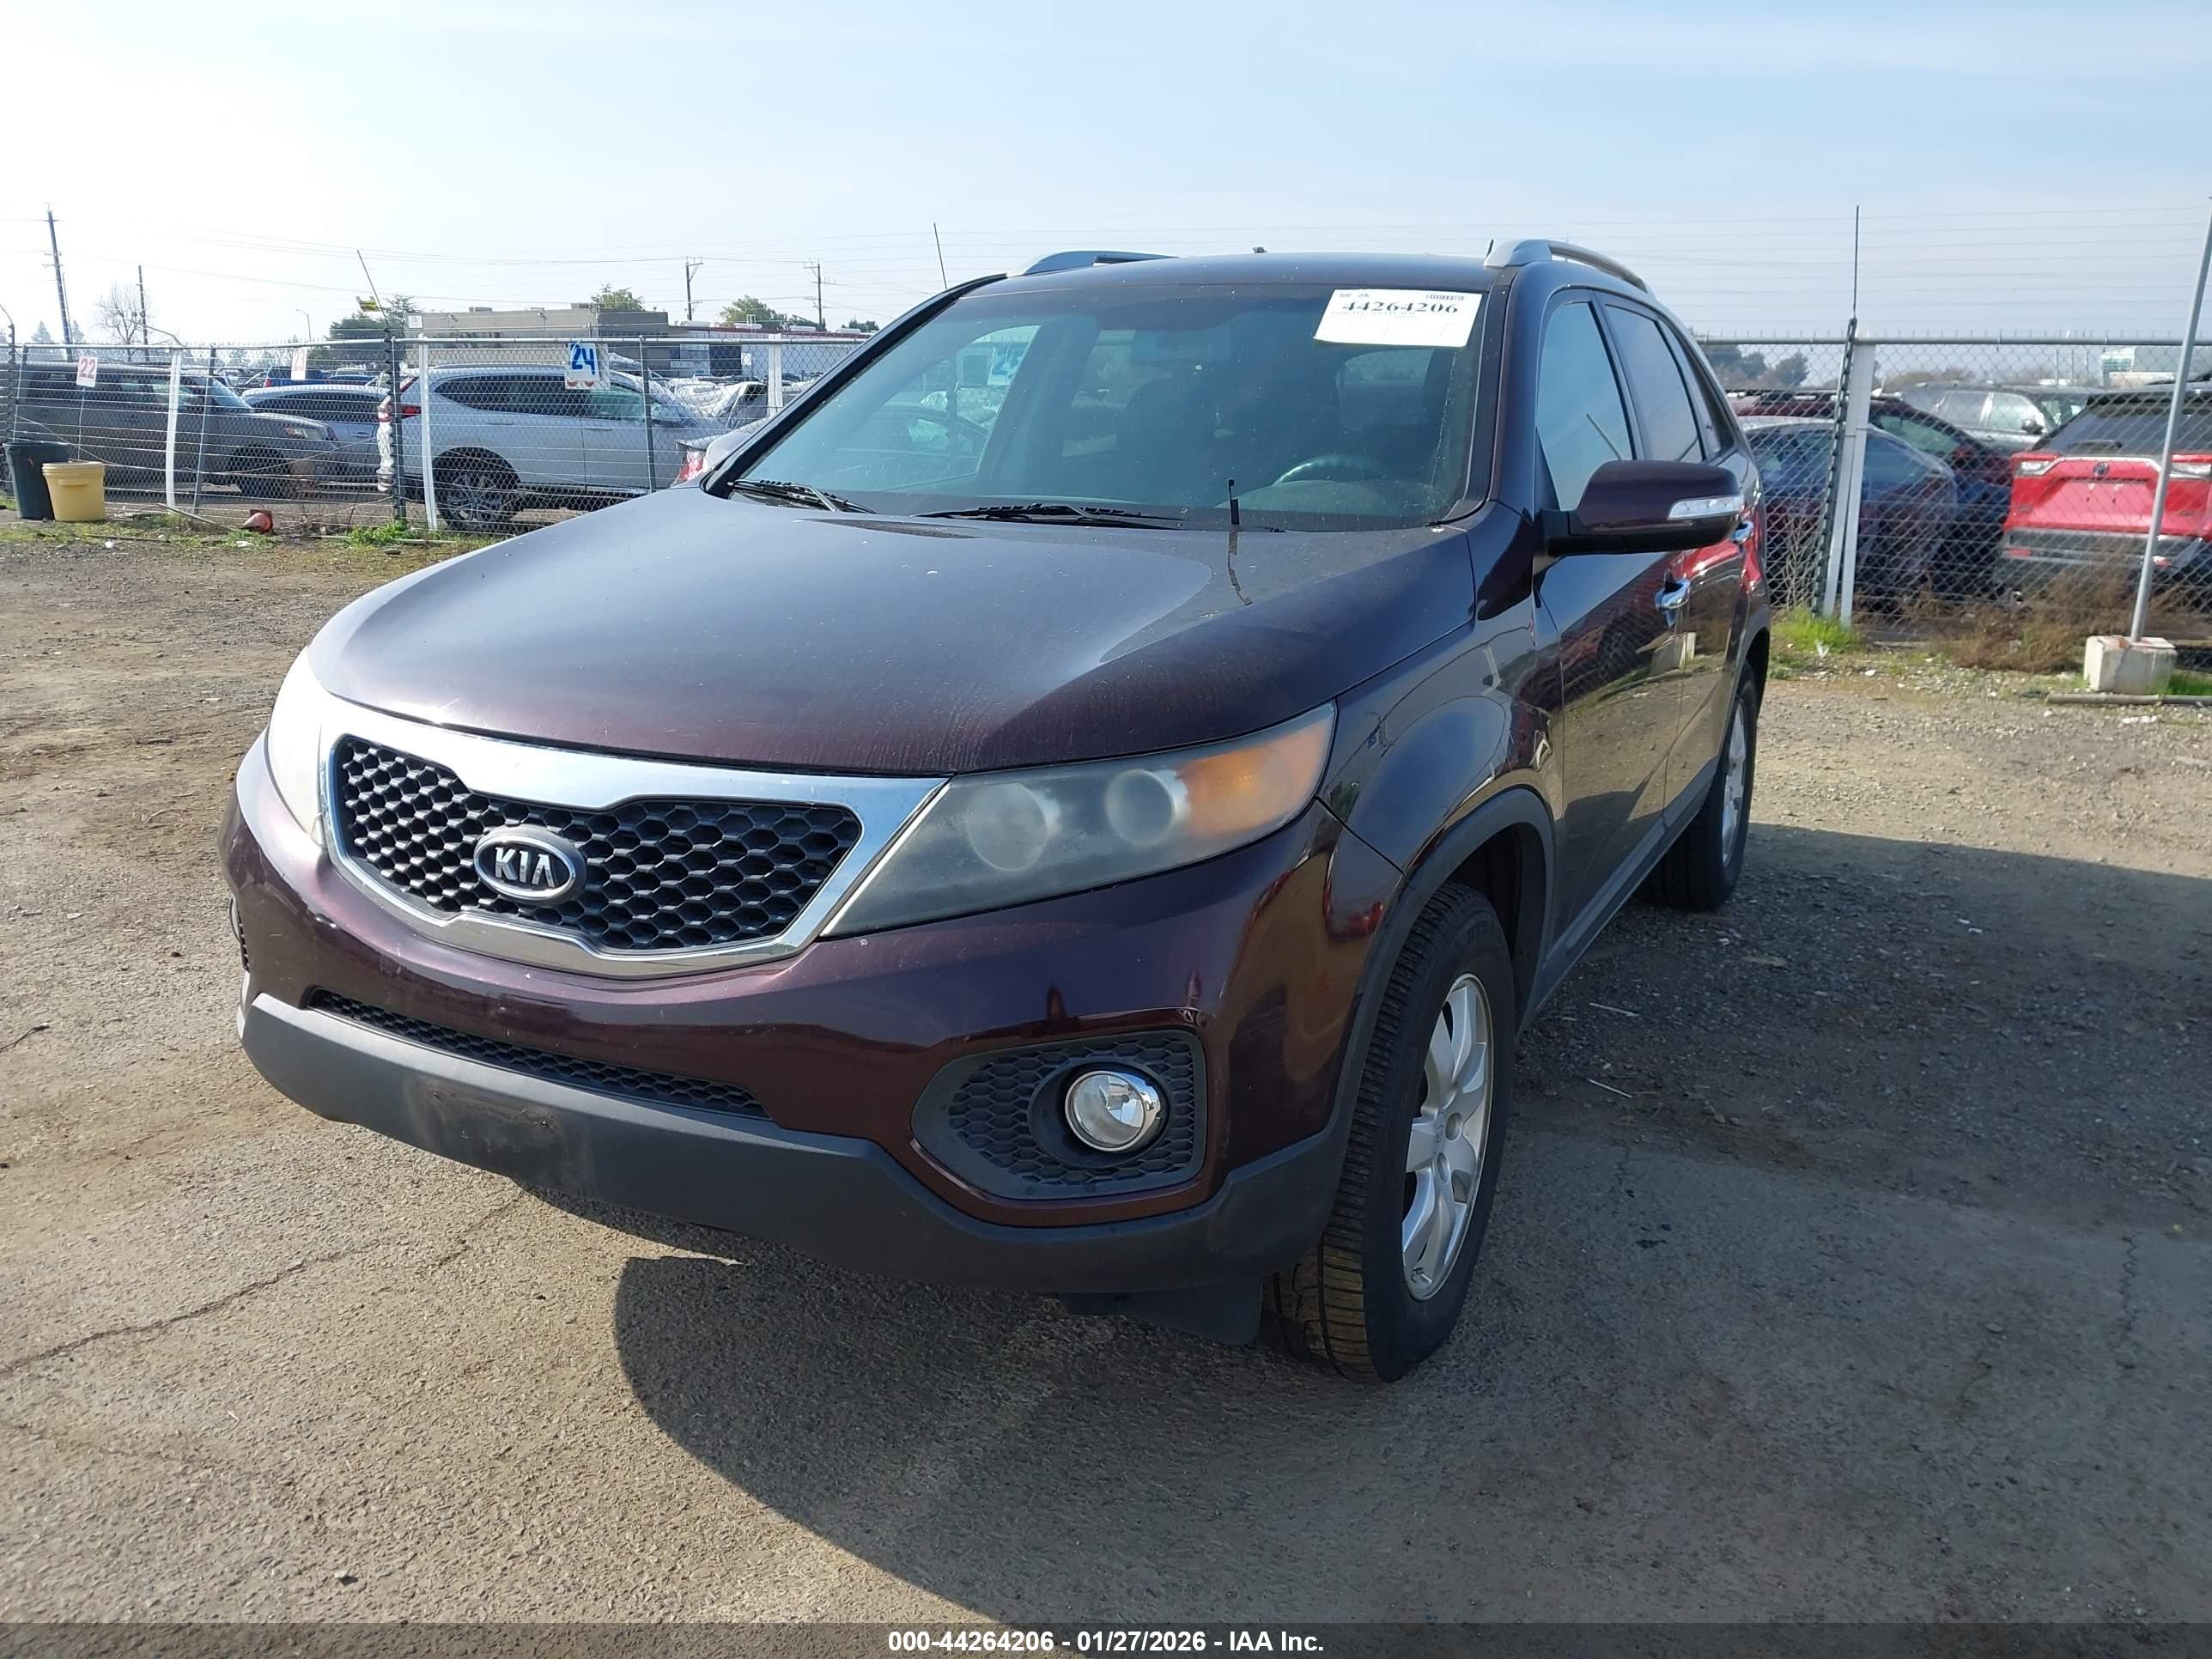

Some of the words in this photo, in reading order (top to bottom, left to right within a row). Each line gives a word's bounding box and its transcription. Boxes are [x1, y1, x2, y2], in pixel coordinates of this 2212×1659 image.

[1341, 301, 1459, 314] 44264206
[79, 357, 96, 380] 22
[570, 343, 595, 375] 24
[495, 847, 556, 888] KIA
